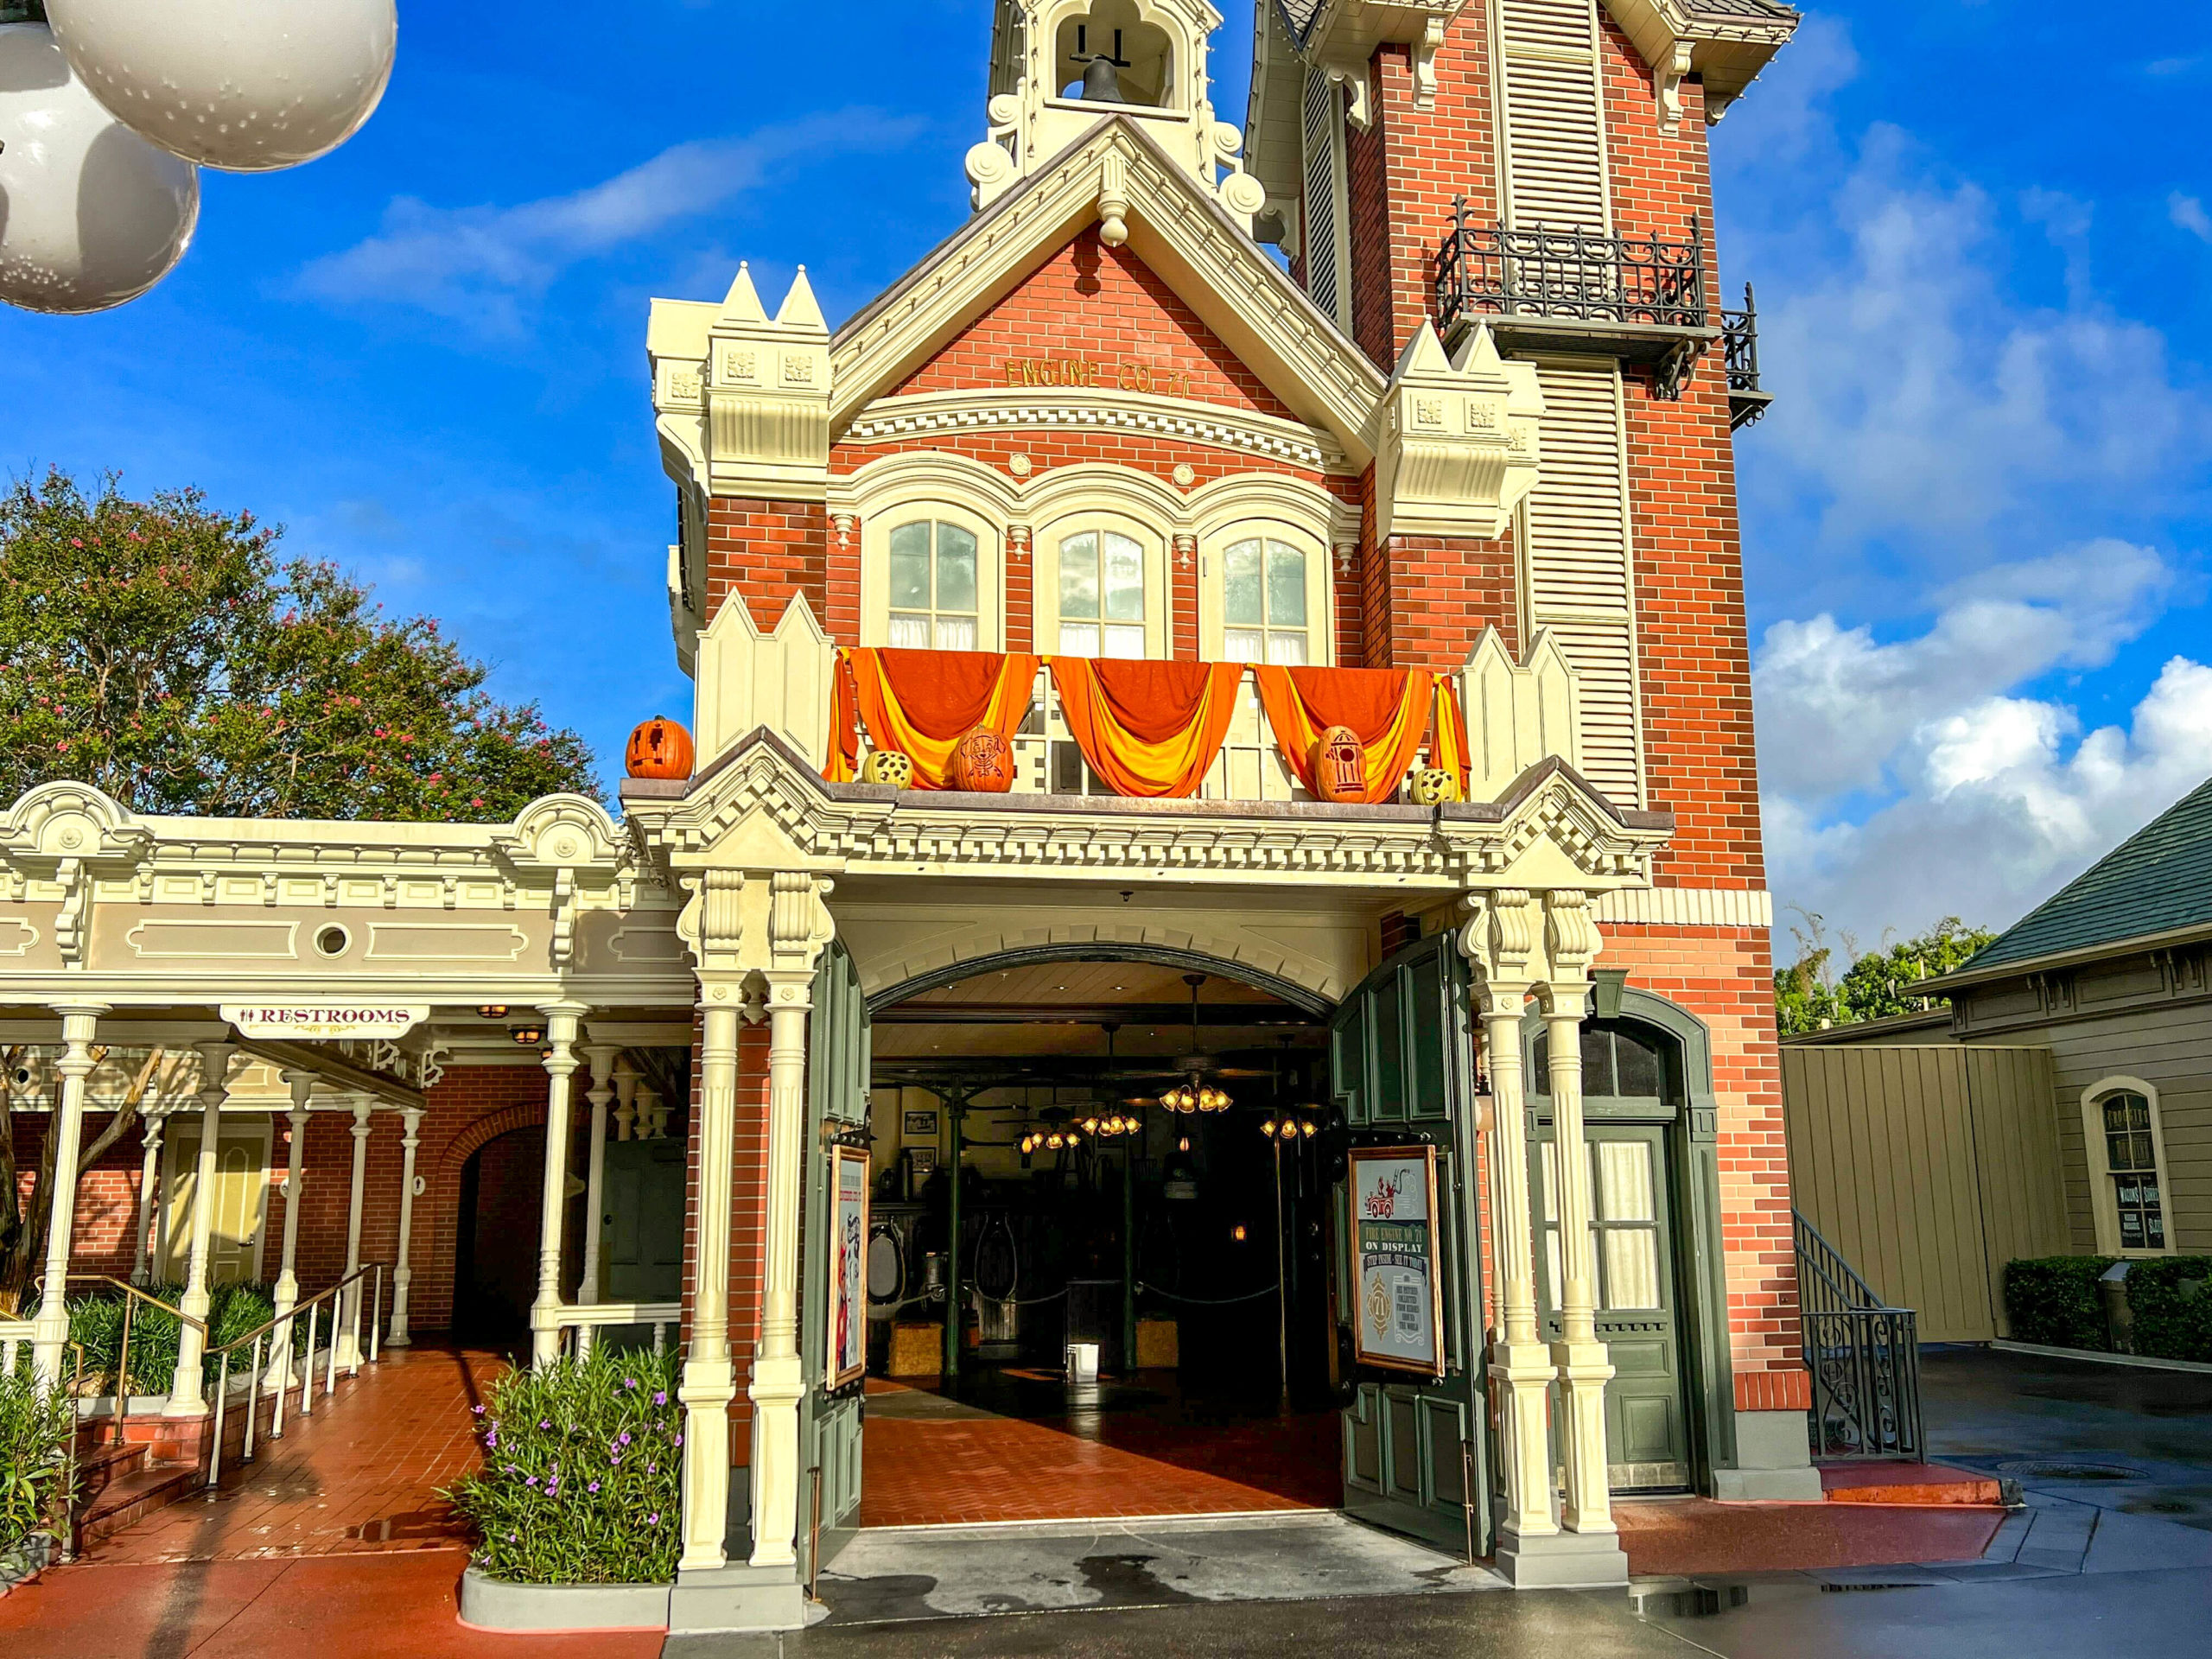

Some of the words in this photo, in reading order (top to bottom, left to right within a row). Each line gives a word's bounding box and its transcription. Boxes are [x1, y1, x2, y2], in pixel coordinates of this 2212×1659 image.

[1004, 359, 1099, 388] ENGINE
[1167, 372, 1188, 398] 71
[259, 1009, 410, 1024] RESTROOMS
[1366, 1228, 1379, 1241] FIRE
[1381, 1228, 1402, 1242] ENGINE
[1415, 1230, 1422, 1243] 71
[1365, 1242, 1378, 1250] ON
[1382, 1243, 1422, 1253] DISPLAY
[1374, 1296, 1385, 1316] 71
